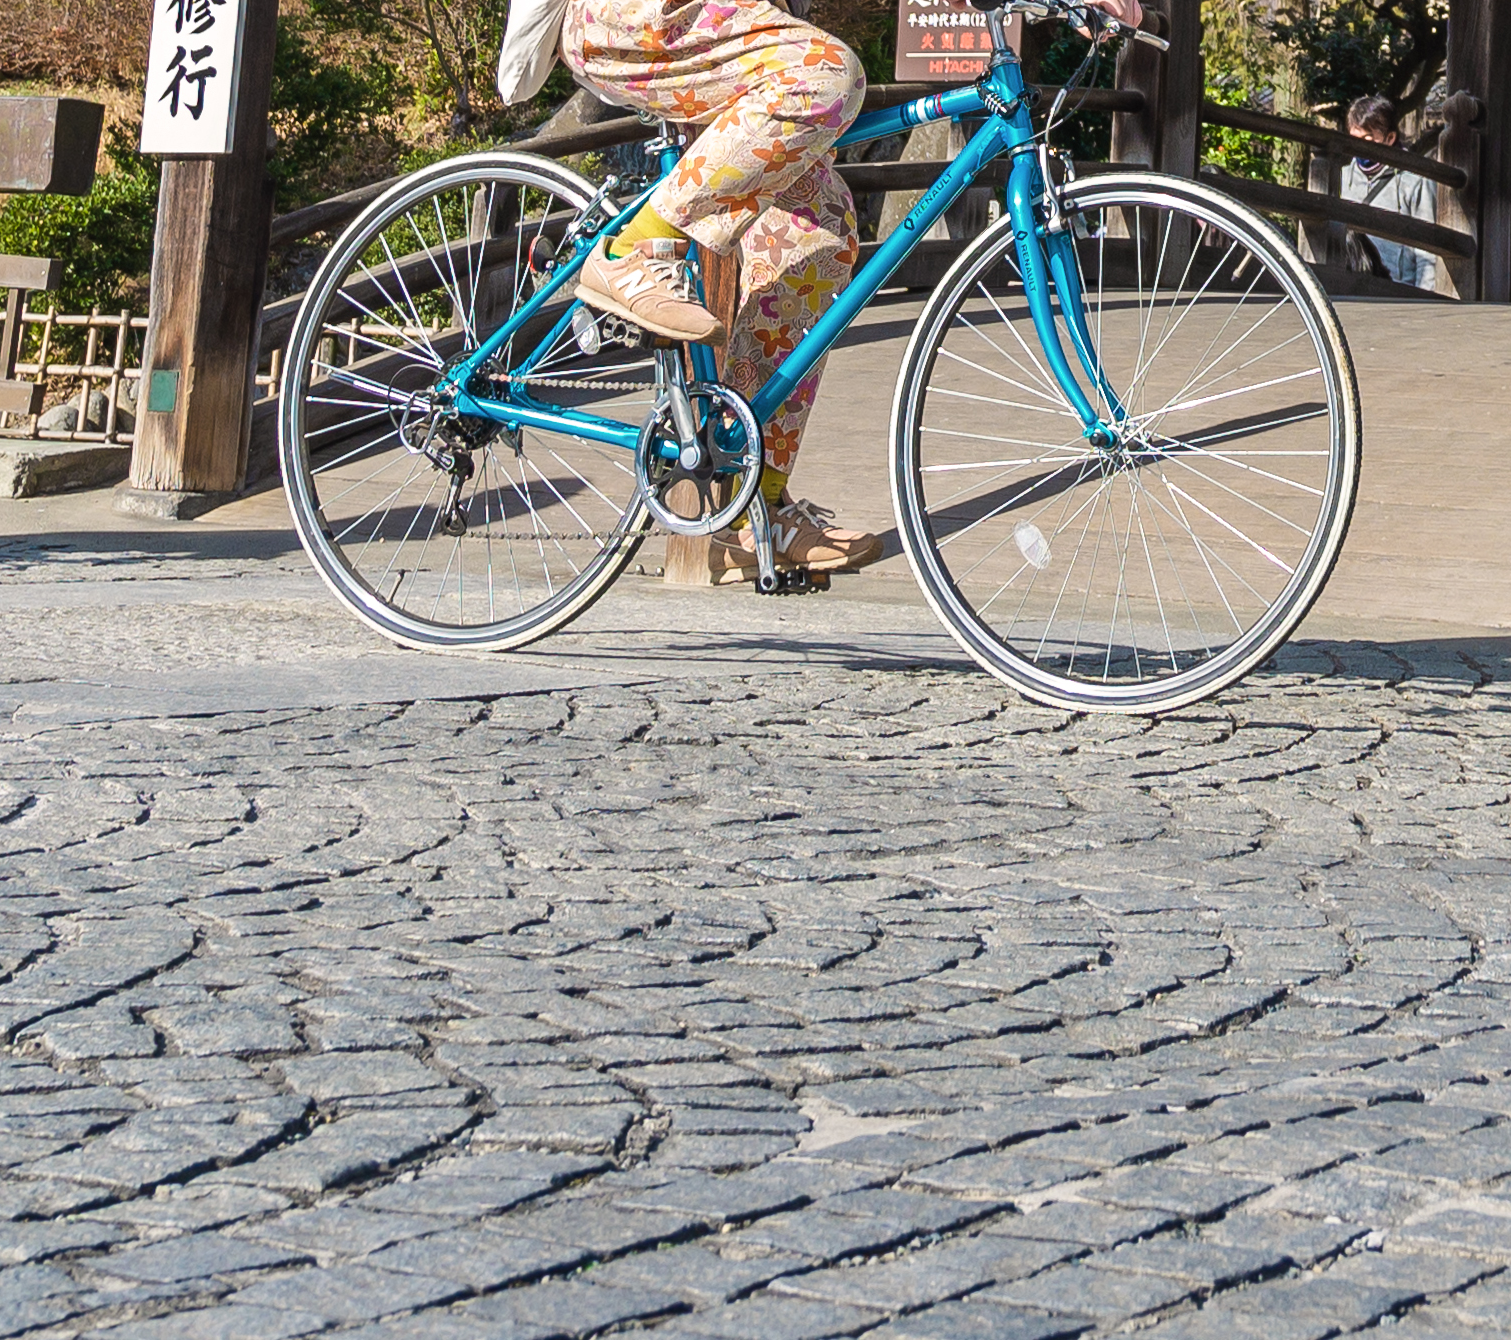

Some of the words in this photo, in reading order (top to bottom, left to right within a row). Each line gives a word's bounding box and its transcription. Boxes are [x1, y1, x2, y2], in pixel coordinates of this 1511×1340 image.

[907, 12, 1013, 28] 平安時代末期(12)
[928, 60, 984, 74] HITACHI
[914, 172, 953, 219] RENAULT
[1020, 243, 1037, 292] RENAULT
[614, 269, 655, 300] N
[771, 522, 799, 554] N
